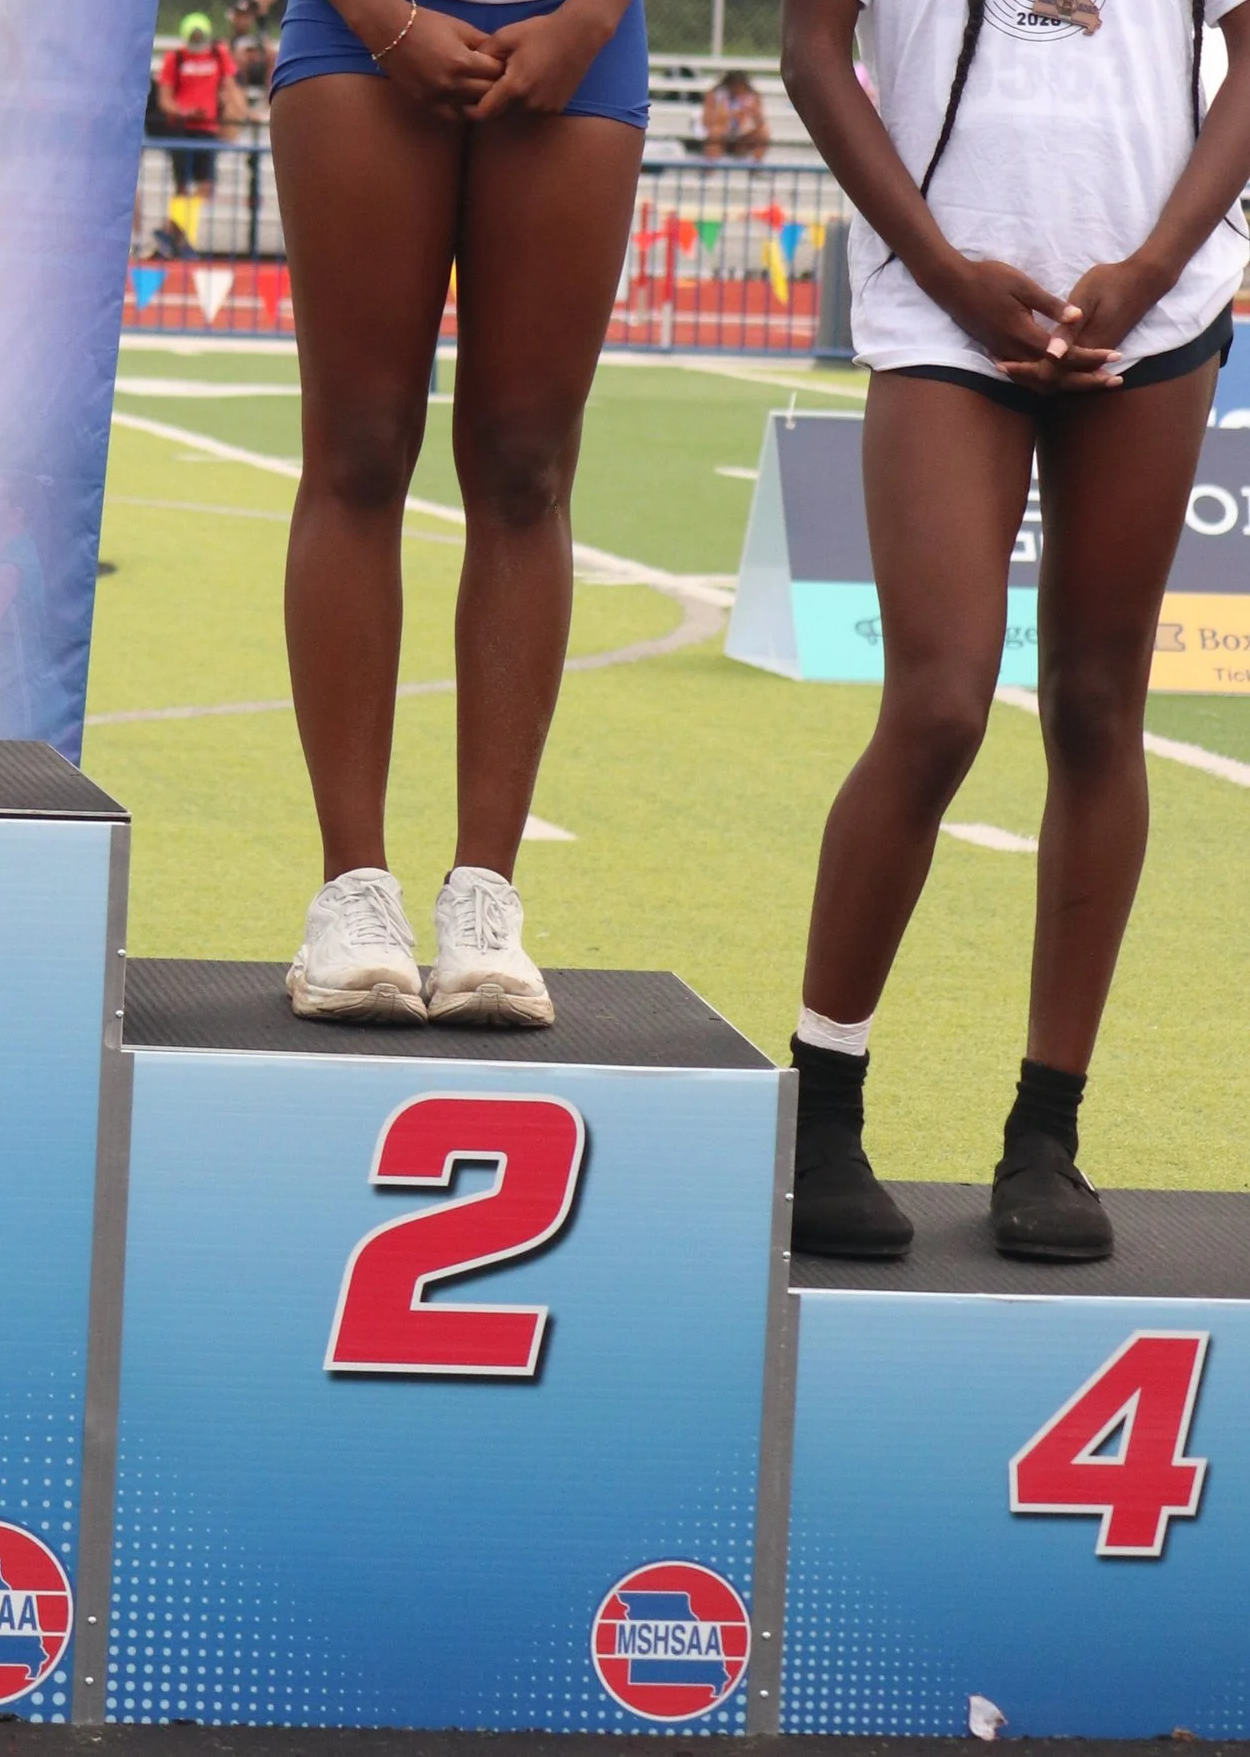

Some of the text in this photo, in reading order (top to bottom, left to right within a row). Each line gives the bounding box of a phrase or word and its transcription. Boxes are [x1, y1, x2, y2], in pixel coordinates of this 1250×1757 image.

[323, 1089, 587, 1377] 2
[1008, 1329, 1211, 1557] 4
[616, 1622, 722, 1658] MSHSAA
